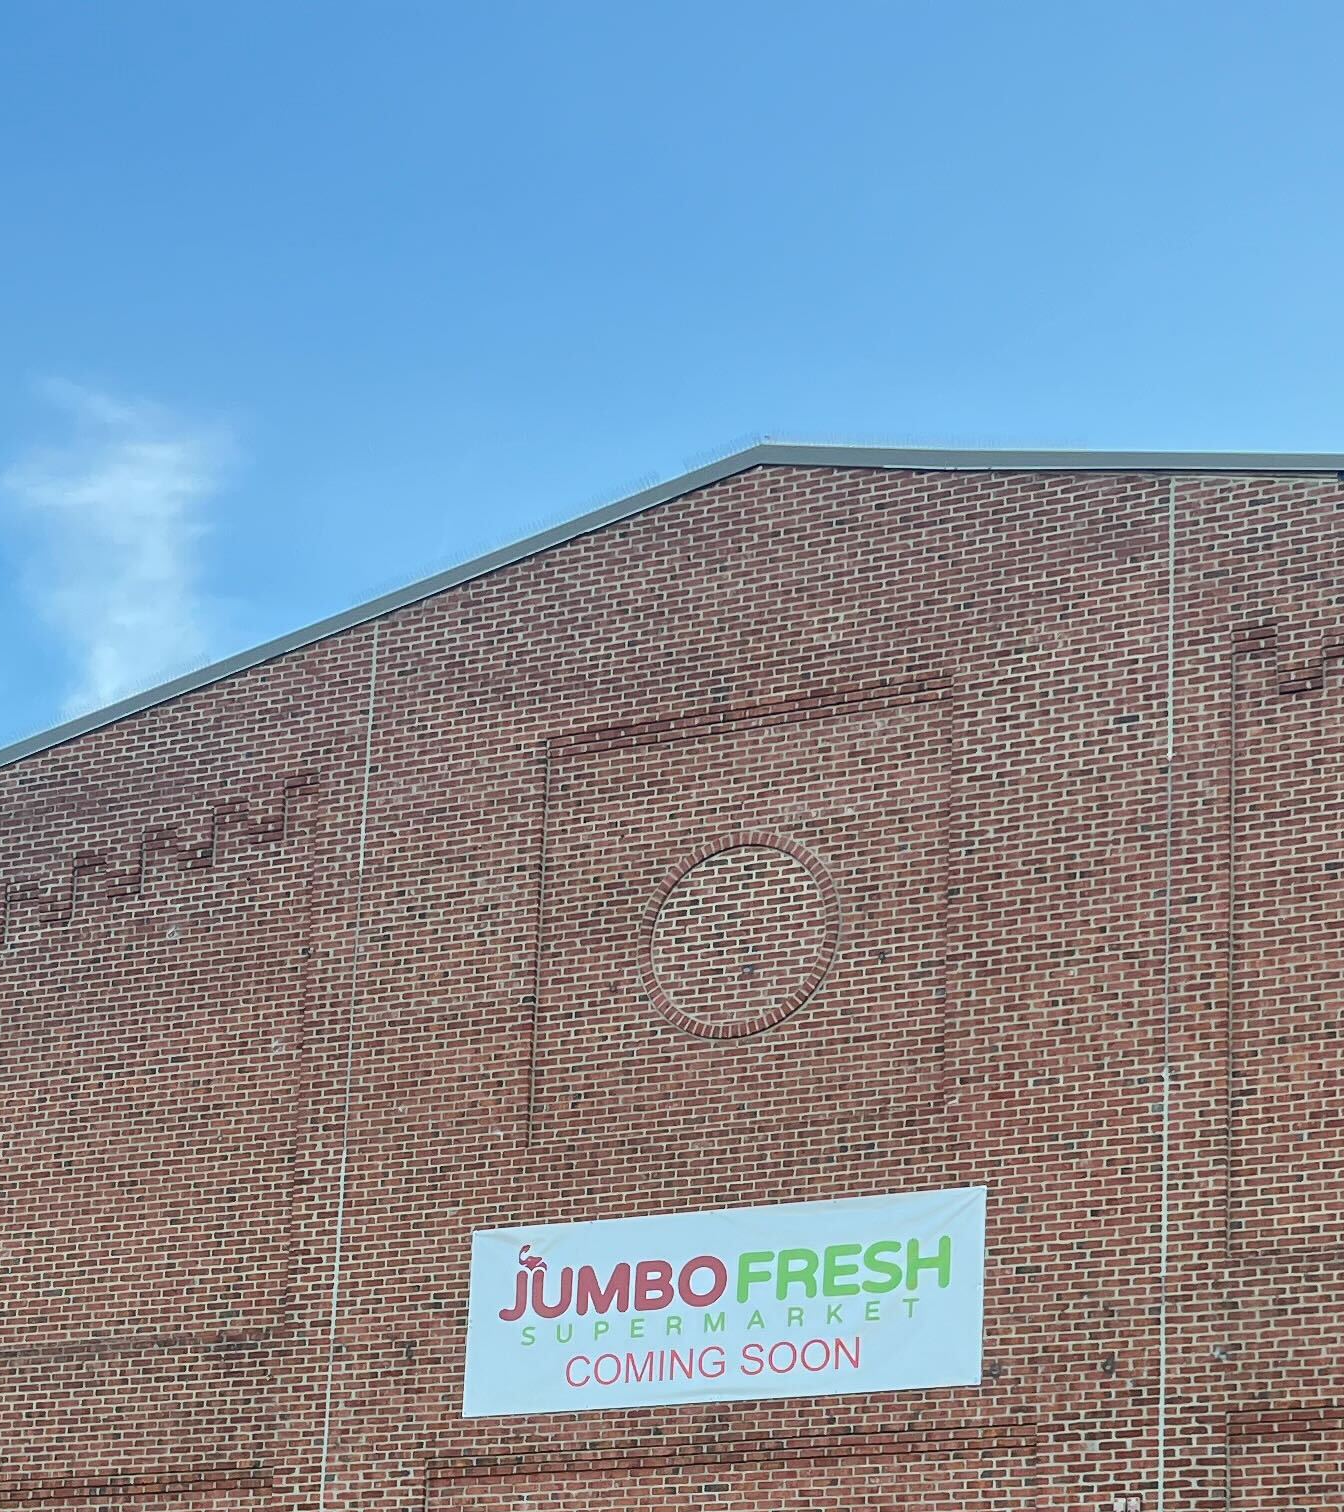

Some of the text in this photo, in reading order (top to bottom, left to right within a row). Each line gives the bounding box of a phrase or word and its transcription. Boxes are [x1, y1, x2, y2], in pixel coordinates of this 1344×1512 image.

[498, 1234, 953, 1322] JUMBO FRESH
[521, 1298, 921, 1346] SUPERMARKET
[565, 1336, 862, 1389] COMING SOON
